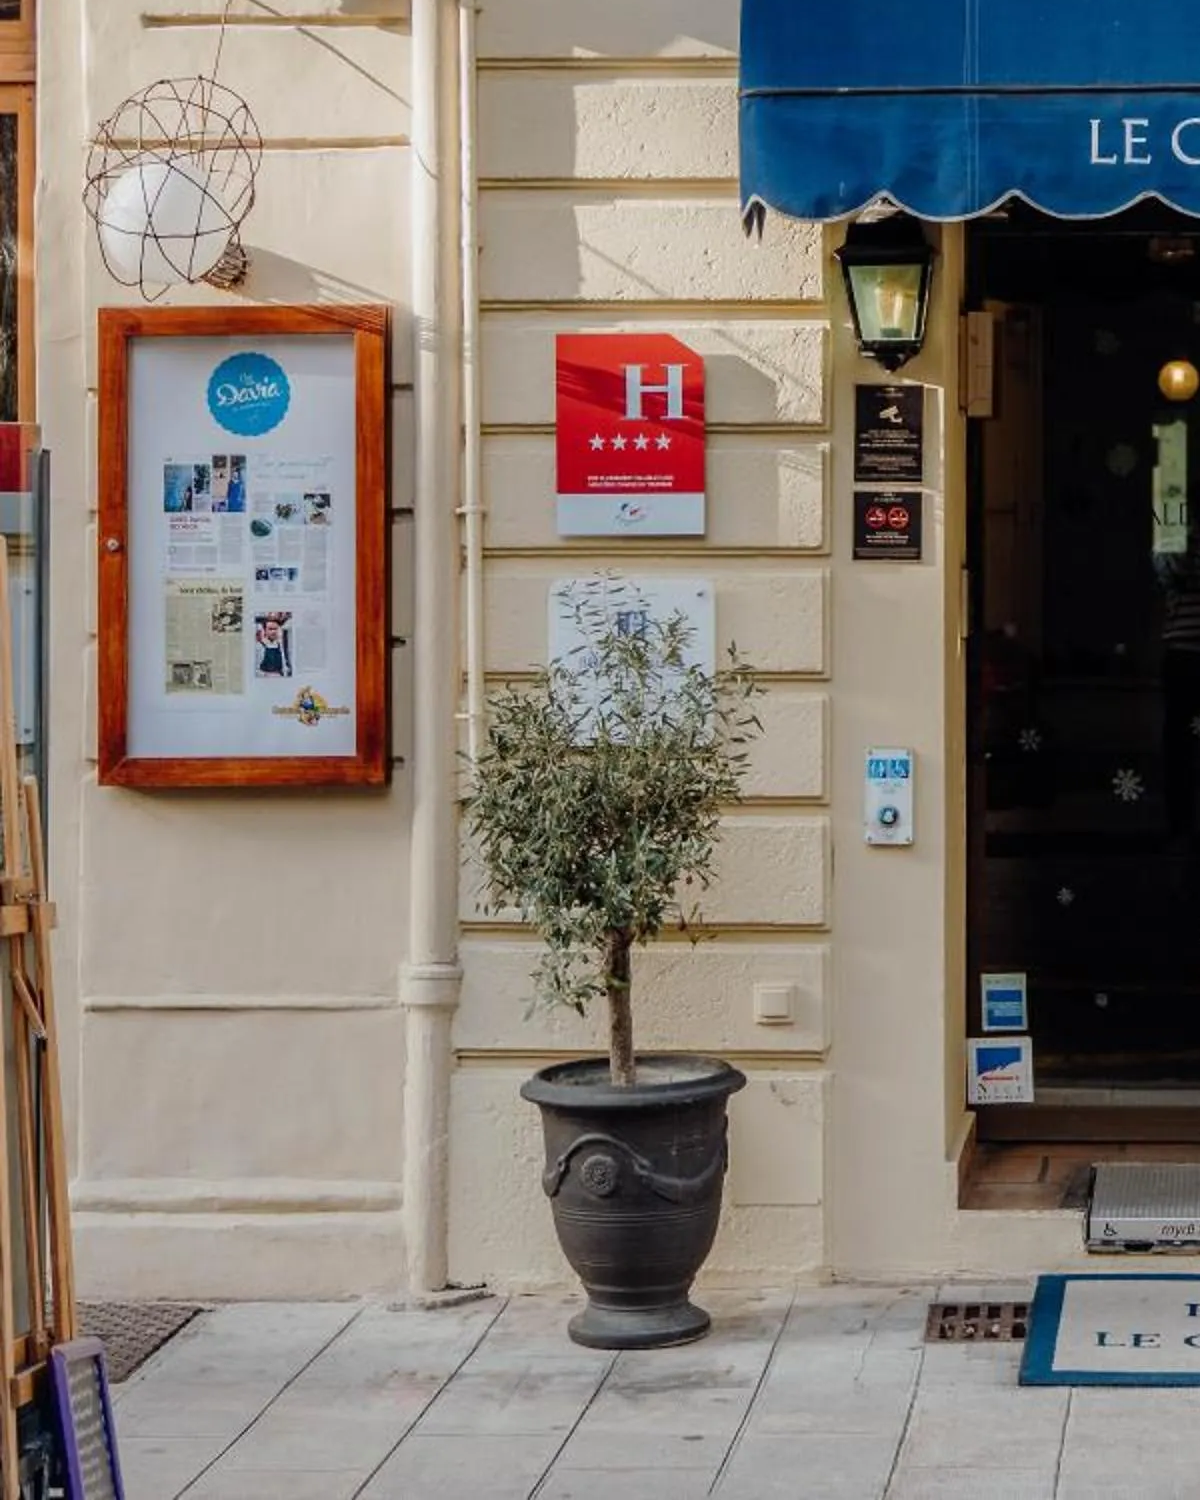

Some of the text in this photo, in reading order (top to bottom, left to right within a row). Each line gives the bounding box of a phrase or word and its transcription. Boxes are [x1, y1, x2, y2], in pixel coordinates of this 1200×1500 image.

[1089, 117, 1152, 166] LE
[216, 376, 282, 407] Davia
[620, 362, 691, 421] H
[1095, 1331, 1161, 1350] LE
